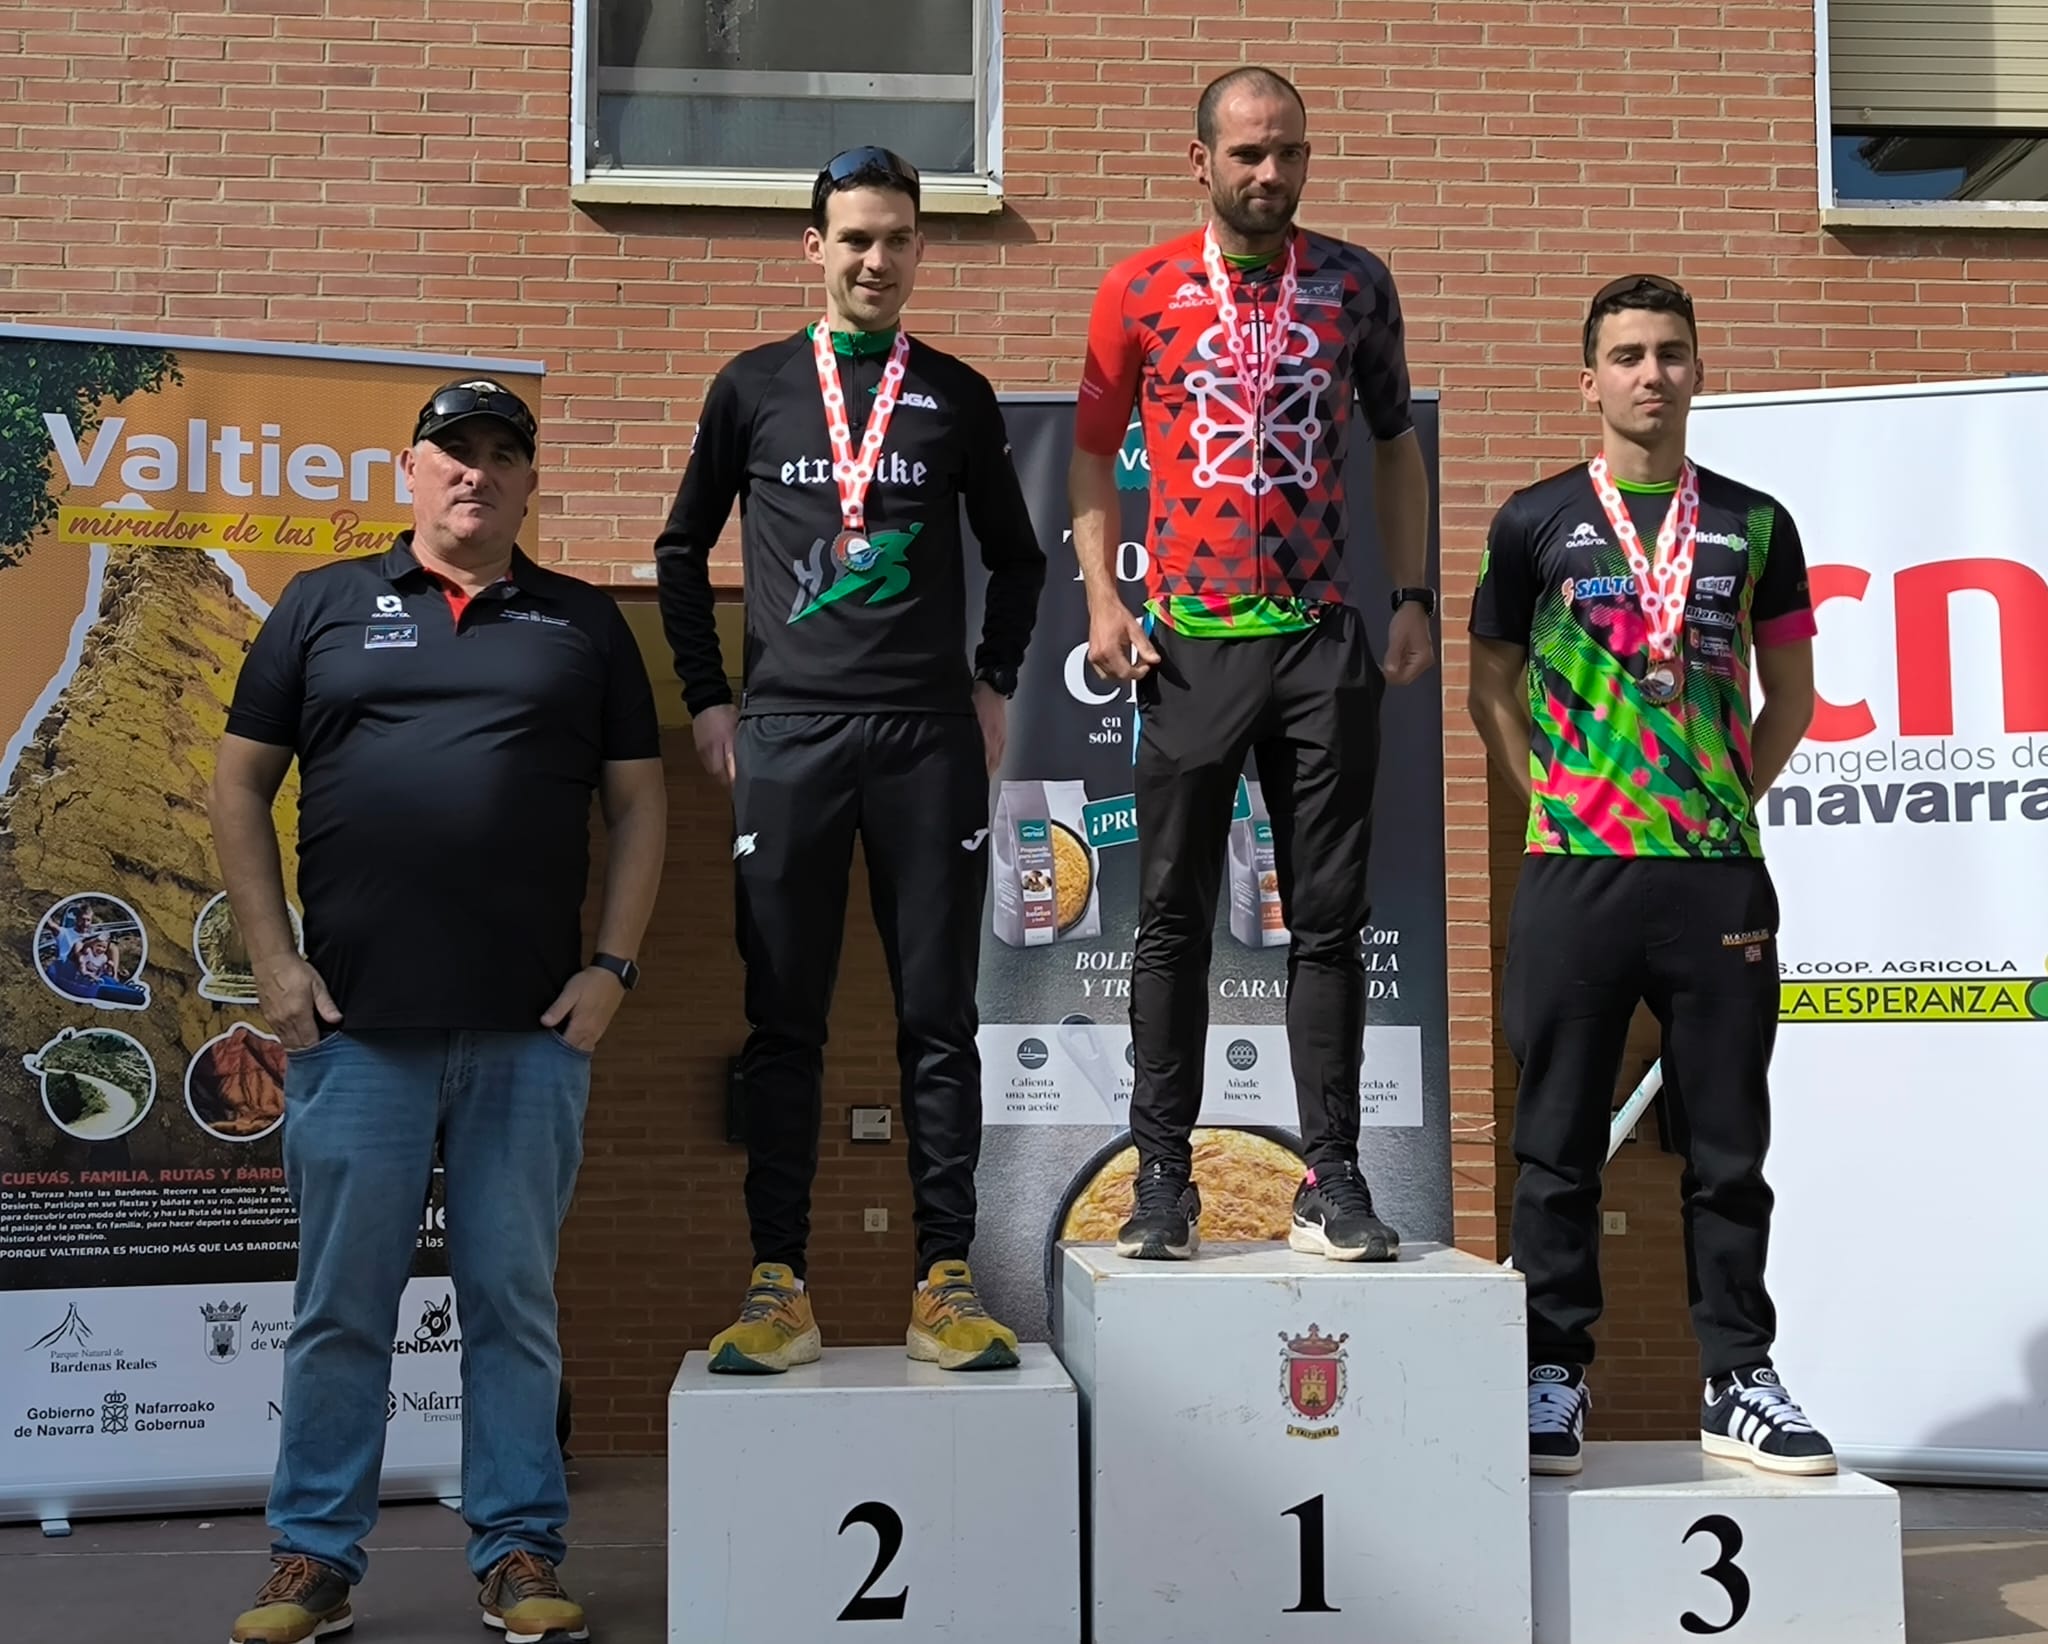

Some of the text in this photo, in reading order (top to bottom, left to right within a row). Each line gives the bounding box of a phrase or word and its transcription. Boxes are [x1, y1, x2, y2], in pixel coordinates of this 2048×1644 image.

[780, 451, 928, 487] etxike
[68, 509, 213, 541] mirador
[222, 512, 264, 544] de
[274, 515, 316, 547] las
[1101, 716, 1122, 728] en
[1088, 729, 1122, 744] solo
[1767, 777, 2048, 827] navarra
[1359, 925, 1400, 945] Con
[1361, 953, 1400, 972] LA
[1881, 960, 2018, 974] AGRICOLA
[1083, 979, 1098, 997] Y
[1011, 1077, 1054, 1088] Calienta
[1226, 1078, 1260, 1089] Añade
[1005, 1091, 1025, 1100] una
[1224, 1090, 1262, 1101] huevos
[1006, 1101, 1060, 1112] con aceite
[160, 1168, 216, 1182] RUTAS
[221, 1168, 232, 1180] Y
[1, 1191, 14, 1200] De
[18, 1191, 27, 1199] la
[68, 1190, 94, 1198] hasta
[97, 1189, 111, 1197] las
[163, 1187, 198, 1196] Recorre
[220, 1186, 257, 1195] caminos
[44, 1200, 85, 1210] Participa
[101, 1200, 117, 1208] sus
[119, 1199, 149, 1208] fiestas
[0, 1213, 22, 1223] para
[23, 1211, 66, 1221] descubrir
[66, 1211, 87, 1220] otro
[88, 1210, 114, 1219] modo
[115, 1210, 127, 1218] de
[160, 1208, 177, 1217] haz
[178, 1208, 187, 1216] la
[187, 1208, 210, 1217] Ruta
[211, 1207, 222, 1216] de
[223, 1207, 236, 1215] las
[238, 1206, 269, 1215] Salinas
[269, 1206, 290, 1217] para
[0, 1224, 9, 1233] el
[11, 1223, 44, 1233] paisaje
[45, 1222, 57, 1231] de
[59, 1222, 68, 1230] la
[96, 1220, 108, 1229] En
[146, 1219, 168, 1230] para
[168, 1219, 195, 1229] hacer
[195, 1218, 231, 1229] deporte
[240, 1217, 282, 1226] descubrir
[0, 1234, 36, 1244] historia
[36, 1233, 52, 1243] del
[52, 1232, 77, 1243] viejo
[0, 1248, 47, 1259] PORQUE
[49, 1246, 111, 1257] VALTIERRA
[113, 1245, 127, 1255] ES
[129, 1244, 170, 1255] MUCHO
[172, 1242, 197, 1253] MÁS
[198, 1242, 222, 1253] QUE
[223, 1242, 245, 1252] LAS
[250, 1338, 268, 1351] de
[50, 1349, 124, 1361] Parque Natural de
[50, 1358, 158, 1374] Bardenas Reales
[26, 1406, 96, 1421] Gobierno
[135, 1400, 216, 1415] Nafarroako
[13, 1423, 95, 1438] de Navarra
[134, 1418, 206, 1432] Gobernua
[1281, 1494, 1342, 1613] 1
[836, 1501, 909, 1622] 2
[1680, 1514, 1750, 1635] 3
